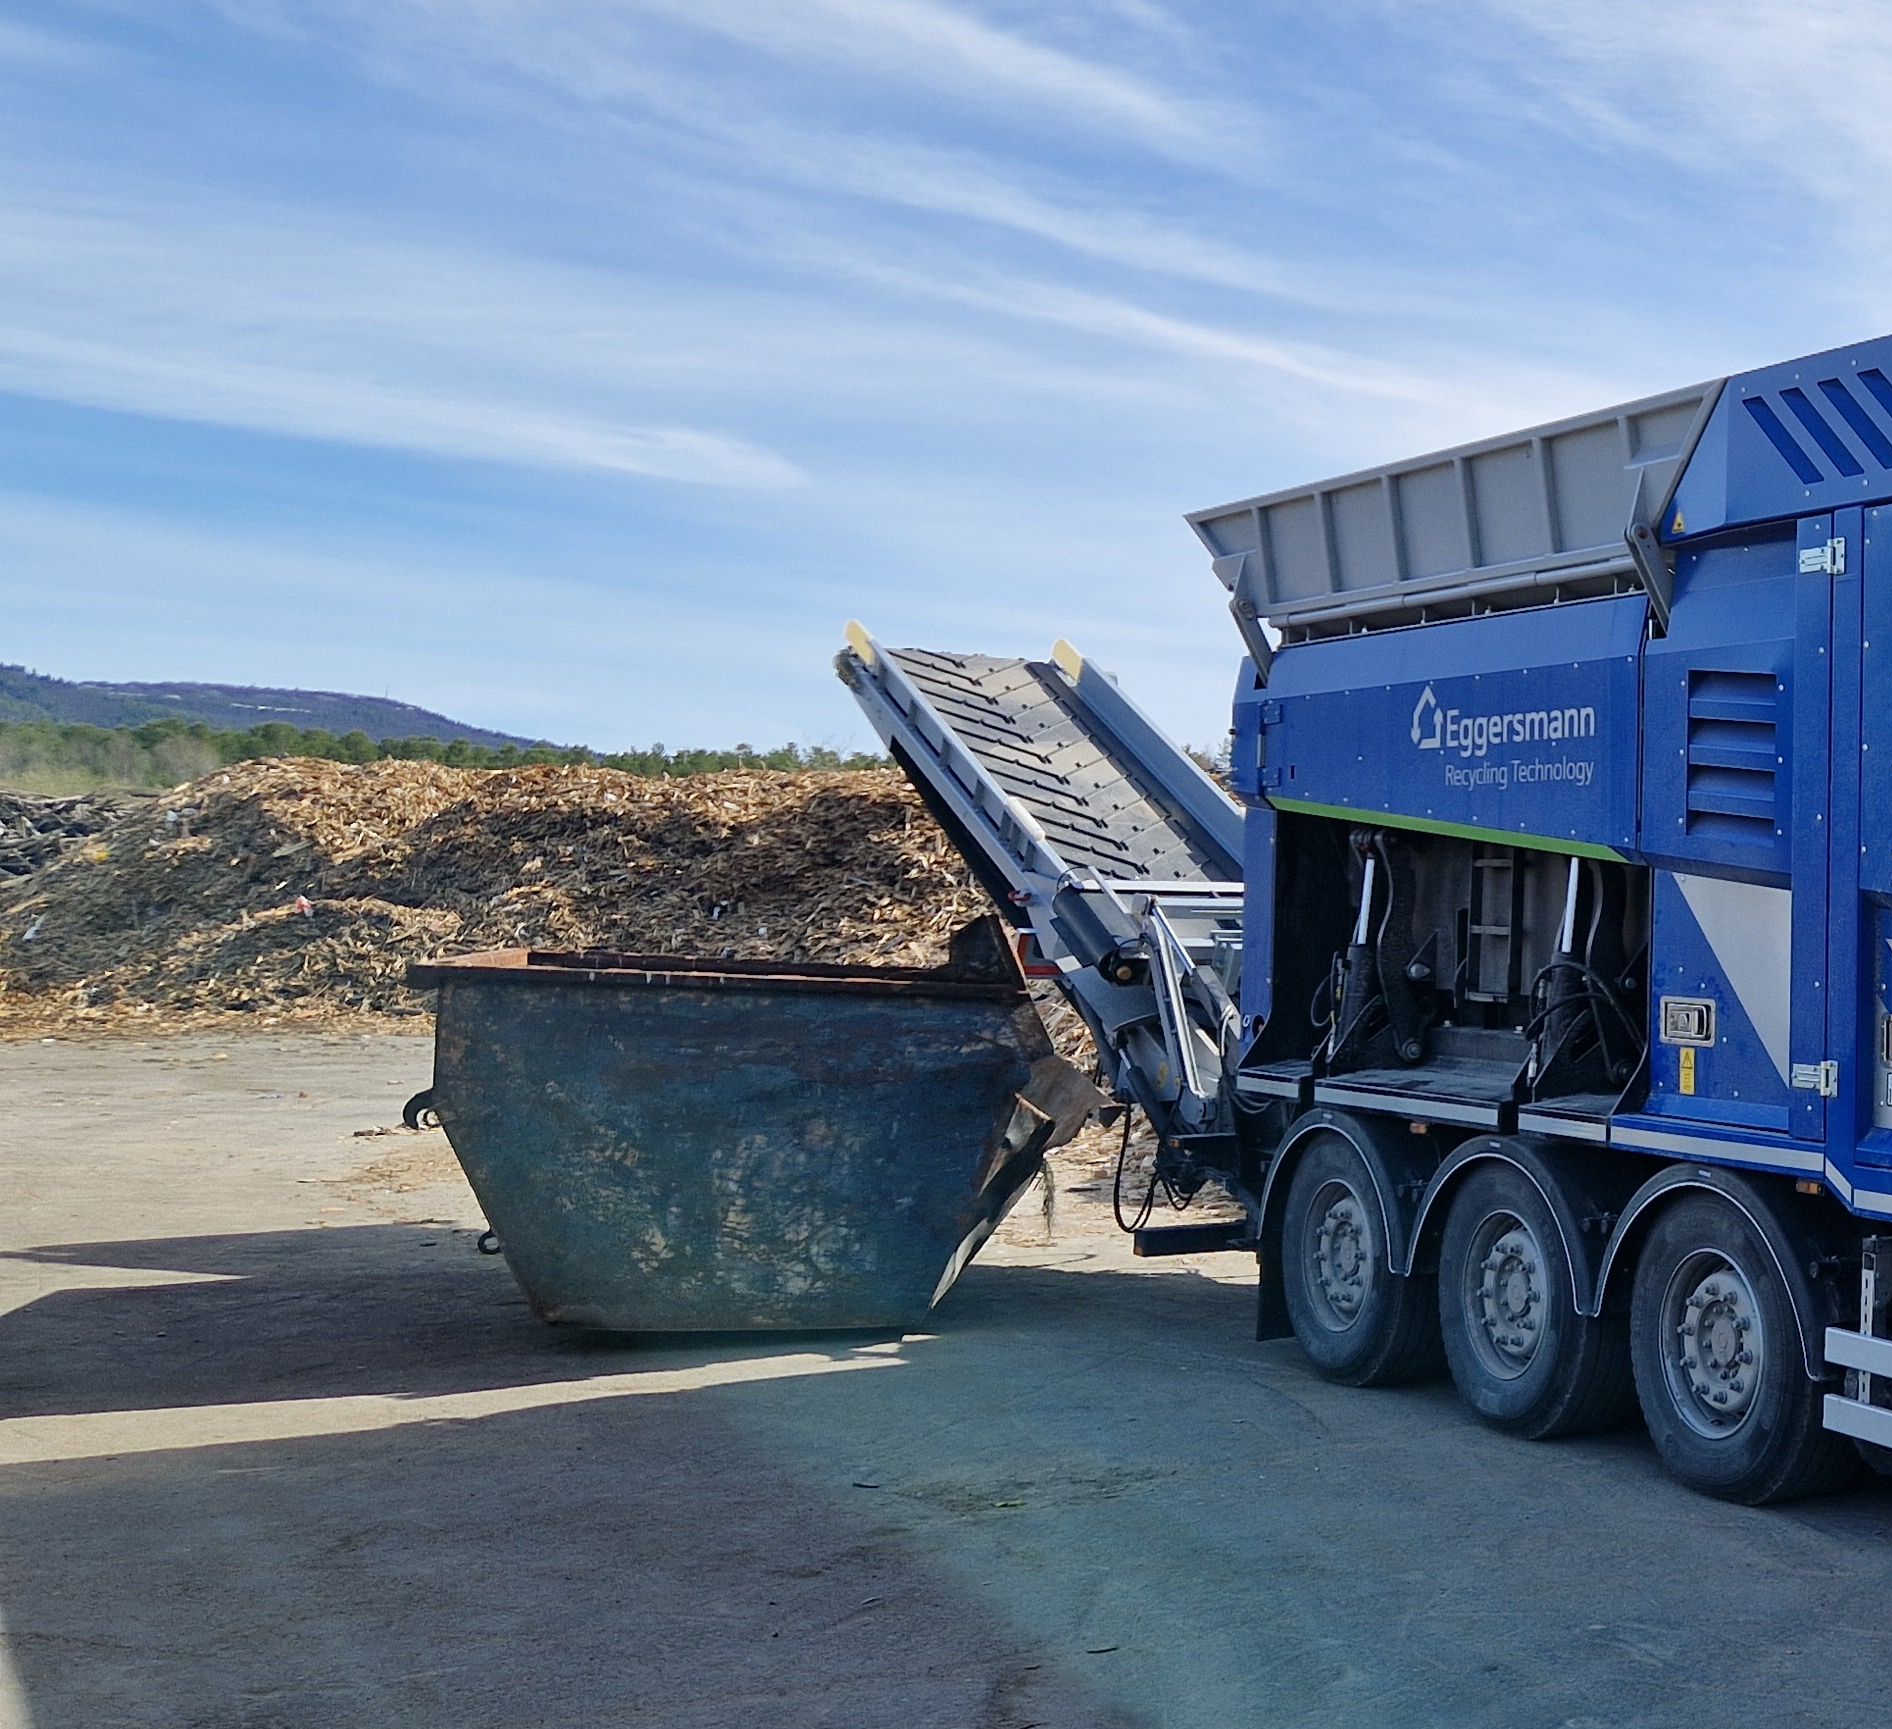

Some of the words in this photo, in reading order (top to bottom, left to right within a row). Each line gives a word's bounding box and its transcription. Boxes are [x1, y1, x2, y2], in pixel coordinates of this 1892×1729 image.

[1445, 706, 1596, 758] Eggersmann
[1444, 761, 1508, 791] Recycling
[1510, 755, 1595, 786] Technology
